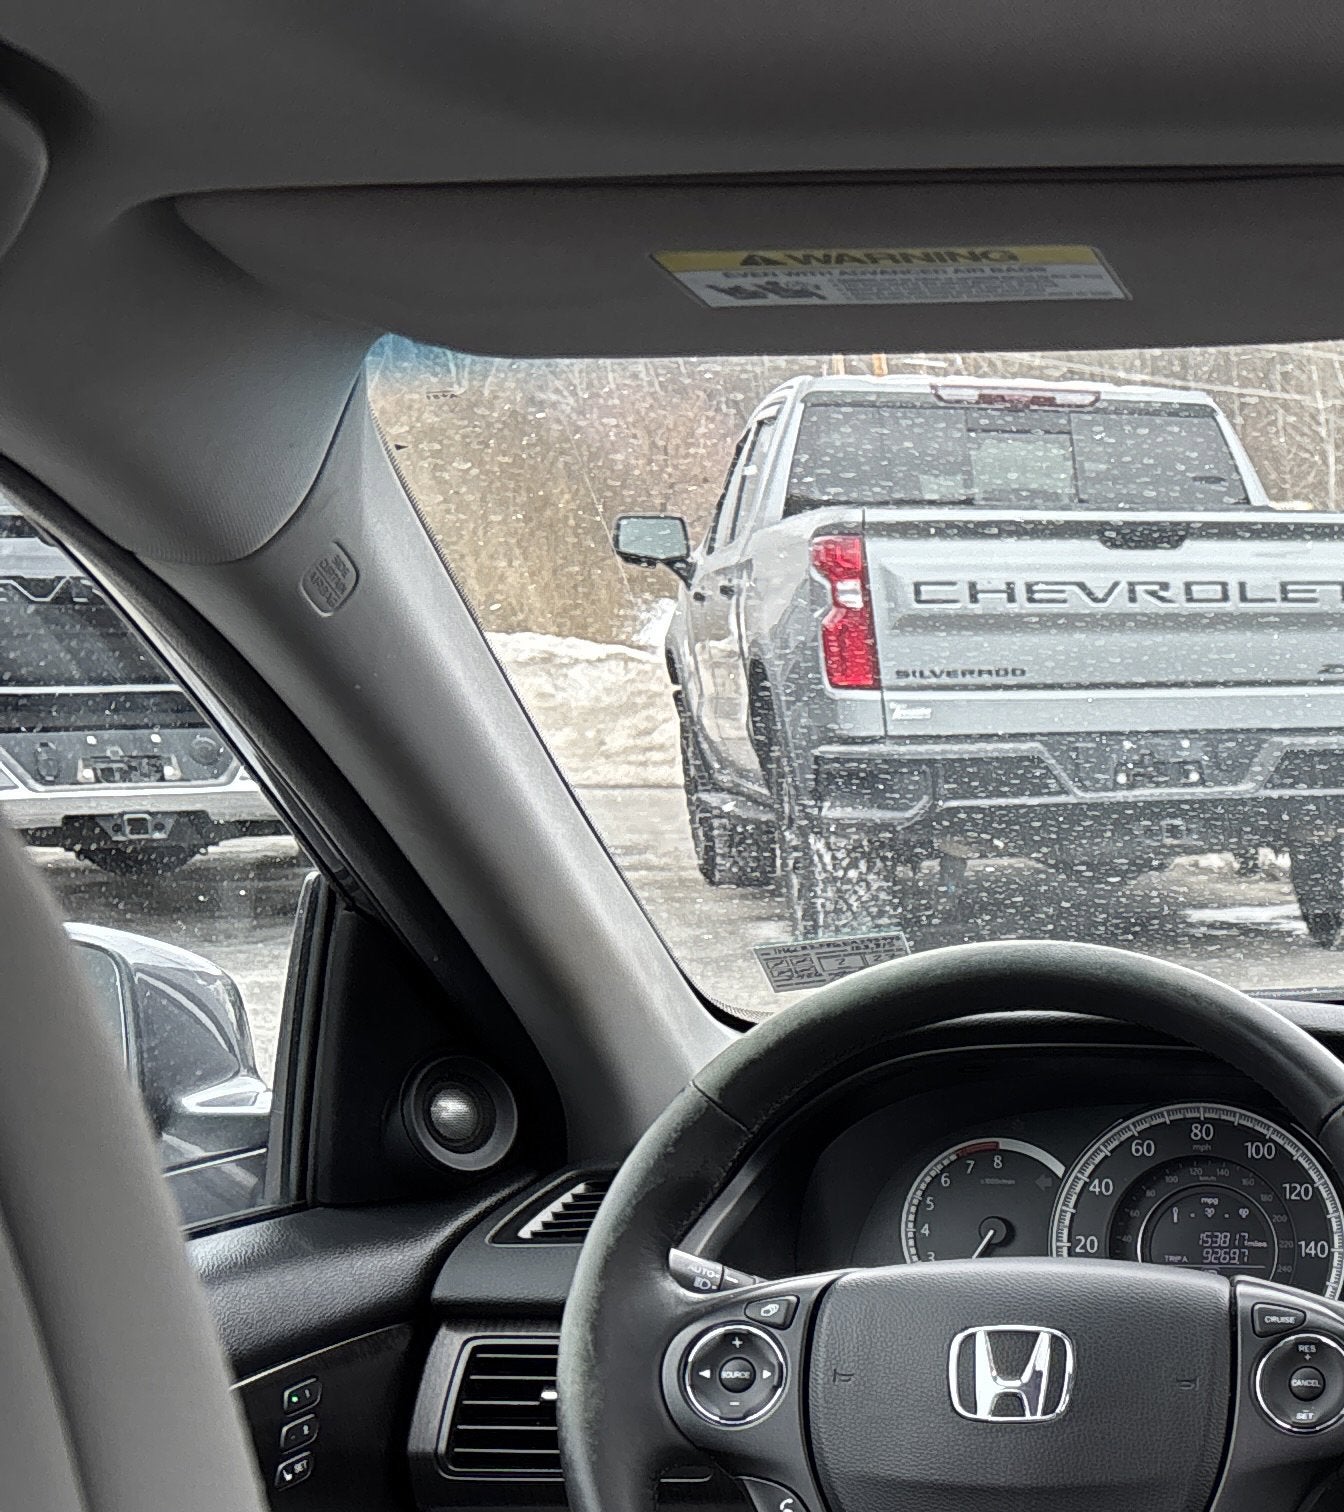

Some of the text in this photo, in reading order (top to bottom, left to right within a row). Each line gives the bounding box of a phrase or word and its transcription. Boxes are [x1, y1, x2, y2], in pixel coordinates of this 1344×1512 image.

[784, 250, 1020, 266] WARNING
[895, 667, 1027, 679] SILVERADO
[1190, 1123, 1214, 1141] 80
[1131, 1139, 1155, 1157] 60
[1192, 1144, 1212, 1152] mph
[1244, 1141, 1276, 1159] 100
[965, 1160, 975, 1174] 7
[993, 1155, 1003, 1169] 8
[940, 1173, 951, 1187] 6
[1088, 1178, 1114, 1196] 40
[1282, 1183, 1313, 1201] 120
[926, 1197, 935, 1211] 5
[1200, 1197, 1219, 1205] mpg
[1272, 1214, 1288, 1223] 200
[920, 1223, 930, 1237] 4
[1075, 1235, 1099, 1253] 20
[1298, 1240, 1329, 1258] 140
[1264, 1315, 1296, 1324] CRUISE
[1298, 1345, 1317, 1353] RES
[721, 1371, 751, 1379] SOURCE
[1291, 1379, 1321, 1387] CANCEL
[1296, 1412, 1315, 1420] SET
